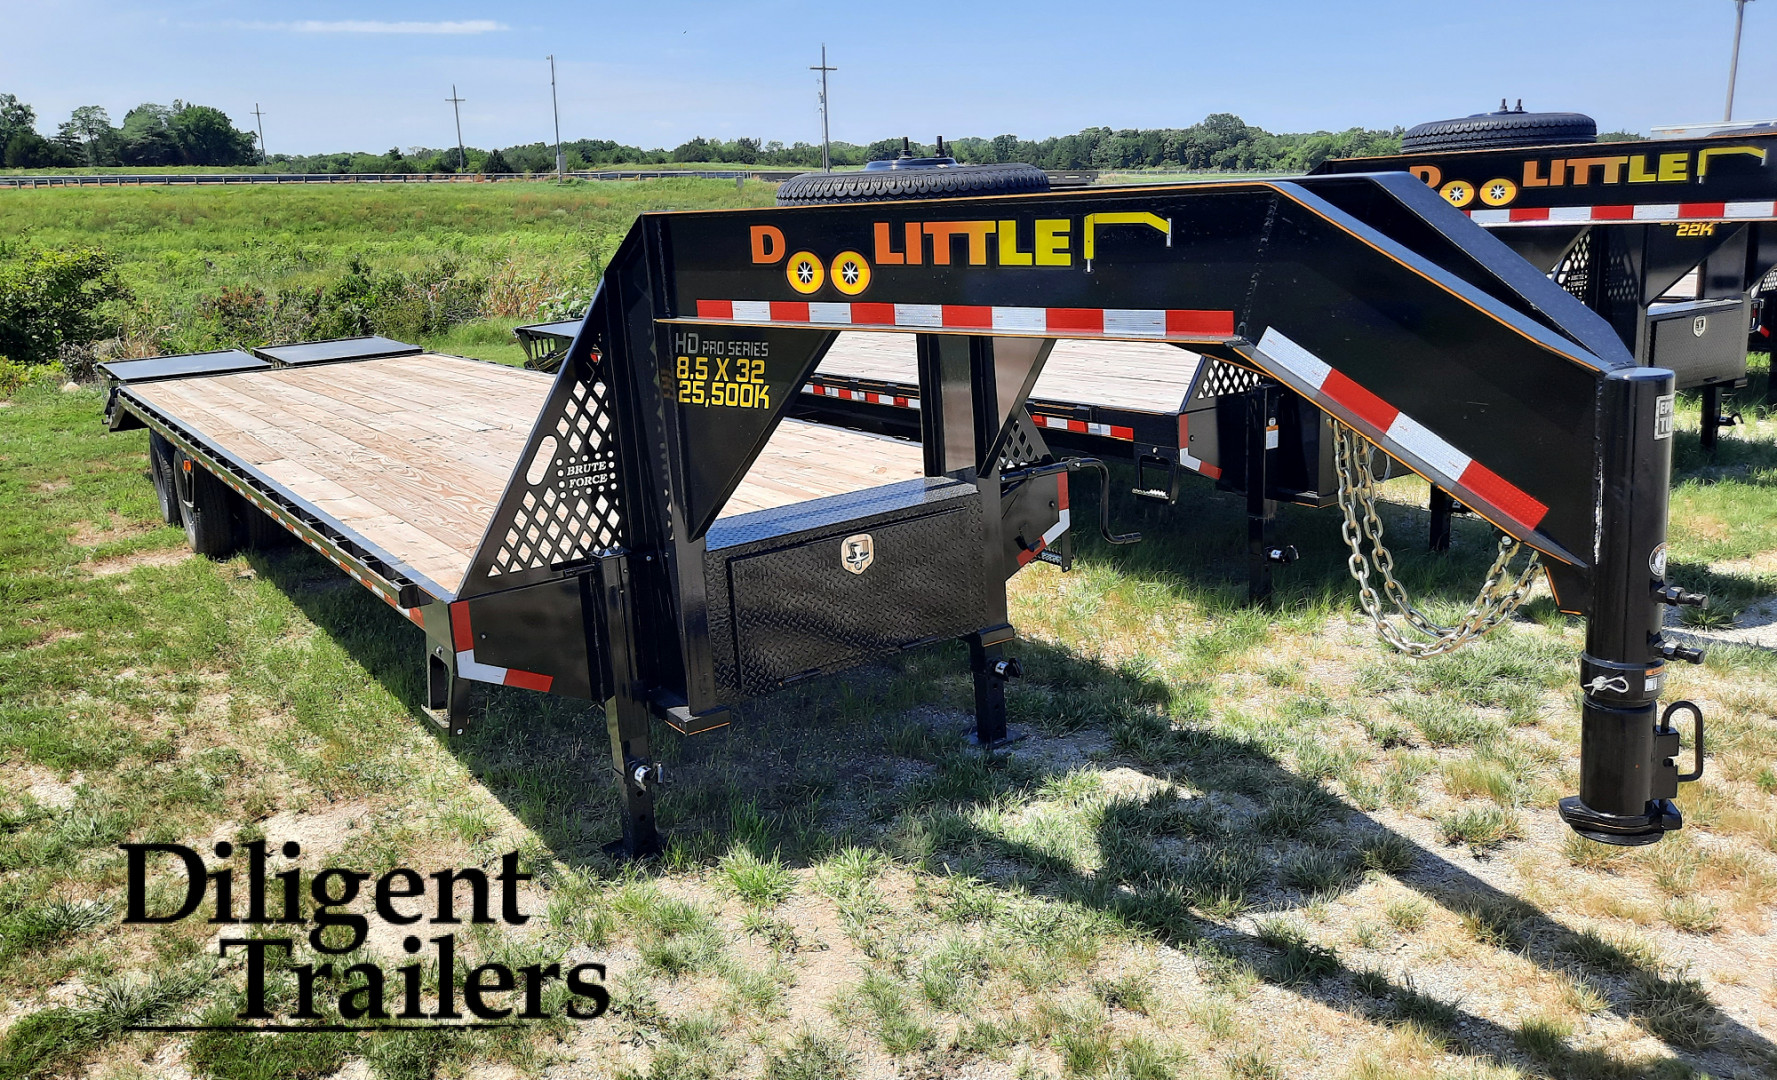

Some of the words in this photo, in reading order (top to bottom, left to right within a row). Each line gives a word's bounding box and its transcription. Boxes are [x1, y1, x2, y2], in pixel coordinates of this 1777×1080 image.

[1676, 223, 1714, 236] 22K
[749, 218, 1072, 296] DOOLITTLE
[675, 332, 699, 354] HD
[702, 341, 724, 355] PRO
[727, 342, 769, 357] SERIES
[676, 356, 709, 380] 8.5
[735, 359, 765, 384] 32
[678, 380, 770, 409] 25,500K
[566, 460, 607, 476] BRUTE
[568, 473, 608, 489] FORCE
